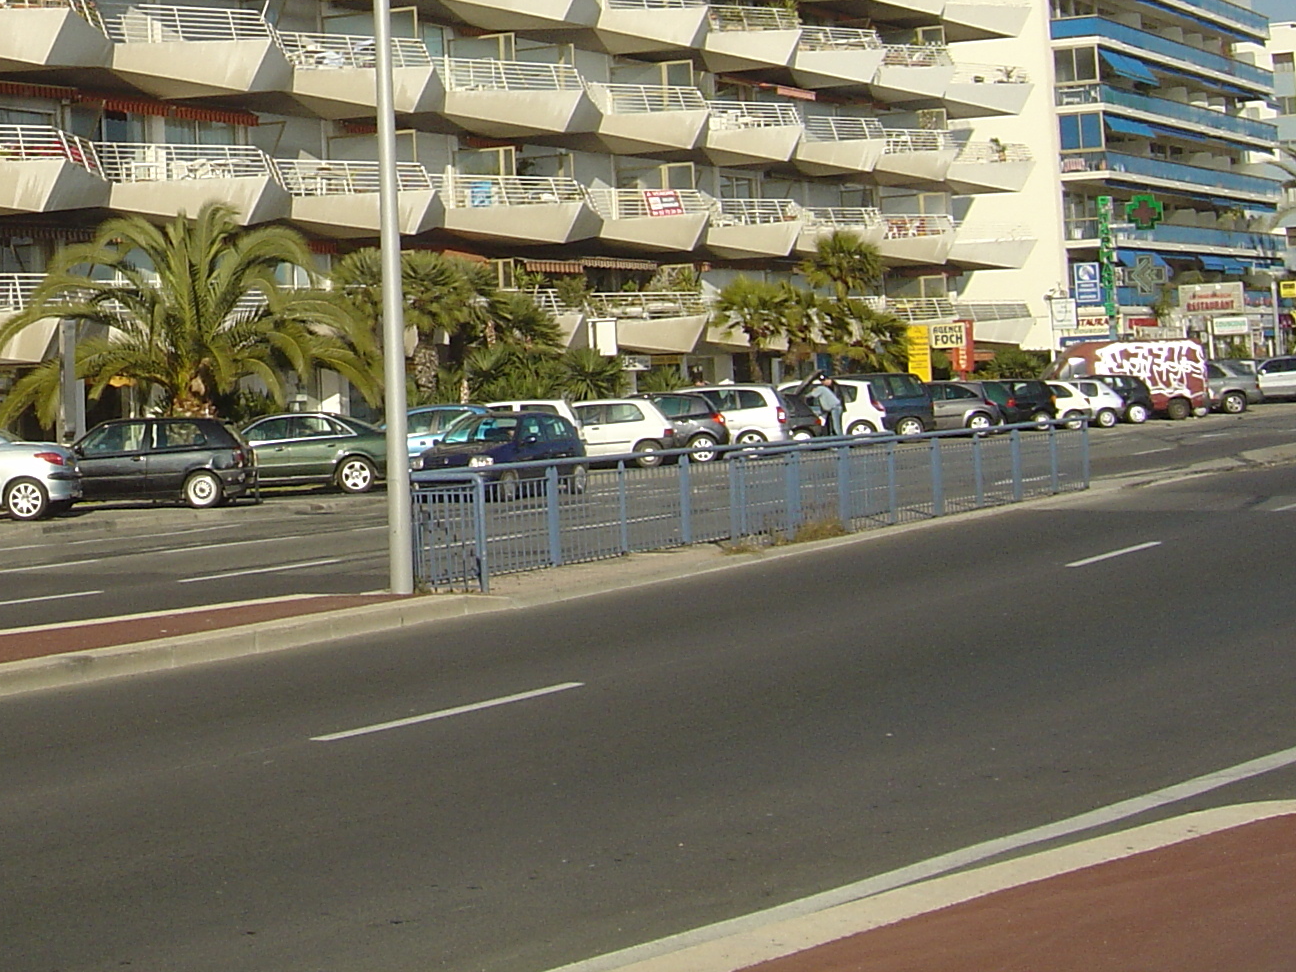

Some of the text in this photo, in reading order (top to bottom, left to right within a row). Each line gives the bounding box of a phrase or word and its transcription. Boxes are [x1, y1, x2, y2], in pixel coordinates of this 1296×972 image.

[1097, 195, 1115, 317] PHARMACIE
[1186, 299, 1234, 312] RESTAURANT
[933, 325, 962, 334] AGENCE
[934, 334, 963, 346] FOCH
